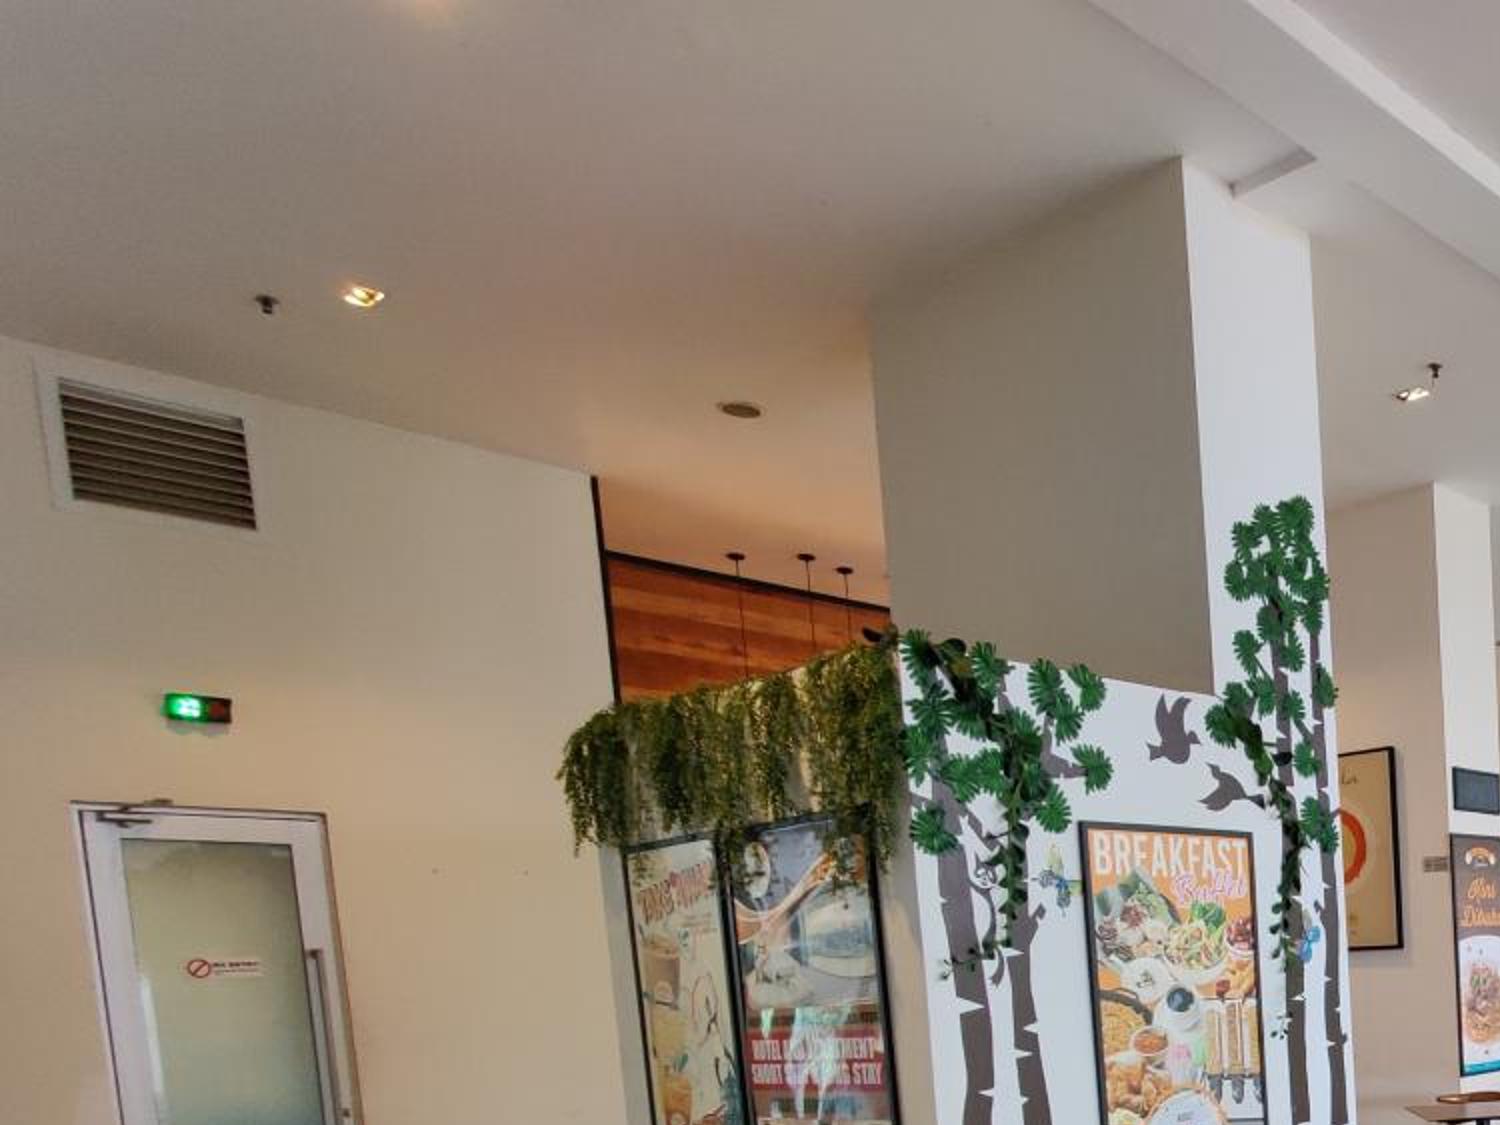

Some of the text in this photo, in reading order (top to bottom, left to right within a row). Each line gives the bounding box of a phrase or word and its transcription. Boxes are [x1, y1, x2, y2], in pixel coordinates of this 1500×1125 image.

[1093, 831, 1247, 878] BREAKFAST
[752, 1063, 784, 1085] SHORT
[852, 1062, 882, 1085] STAY
